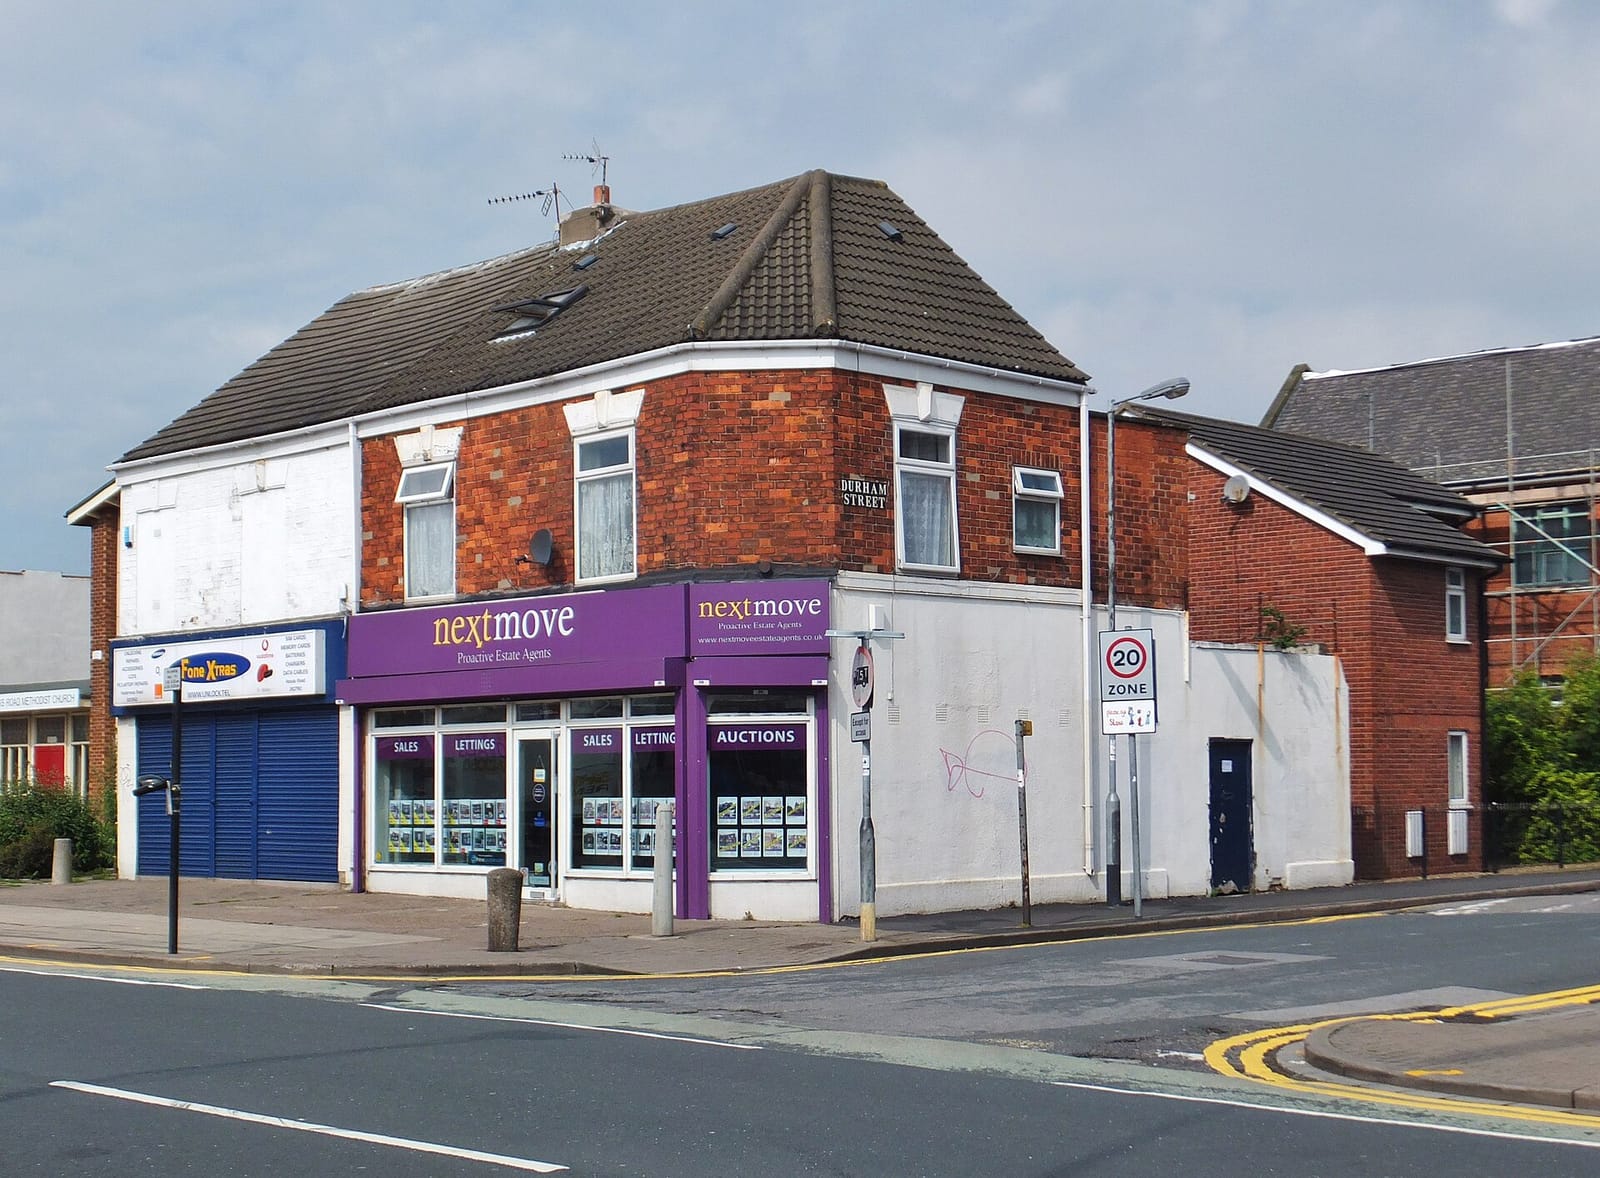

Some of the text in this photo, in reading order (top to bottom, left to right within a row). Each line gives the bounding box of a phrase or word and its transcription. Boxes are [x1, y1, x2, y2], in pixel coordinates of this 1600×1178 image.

[841, 479, 887, 496] DURHAM
[843, 493, 886, 509] STREET
[698, 598, 821, 620] nextmove
[433, 606, 574, 649] nextmove
[718, 621, 802, 630] Proactive Estate Agents
[697, 633, 823, 644] www.nextmoveestateagents.co.uk
[457, 648, 552, 664] Proactive Estate Agents
[1113, 649, 1140, 667] 20
[181, 658, 205, 679] Fone
[1108, 684, 1147, 695] ZONE
[22, 695, 51, 705] METHODIST
[52, 694, 75, 704] CHURCH
[583, 734, 613, 747] SALES
[717, 730, 795, 743] AUCTIONS
[394, 741, 419, 753] SALES
[455, 738, 496, 751] LETTINGS
